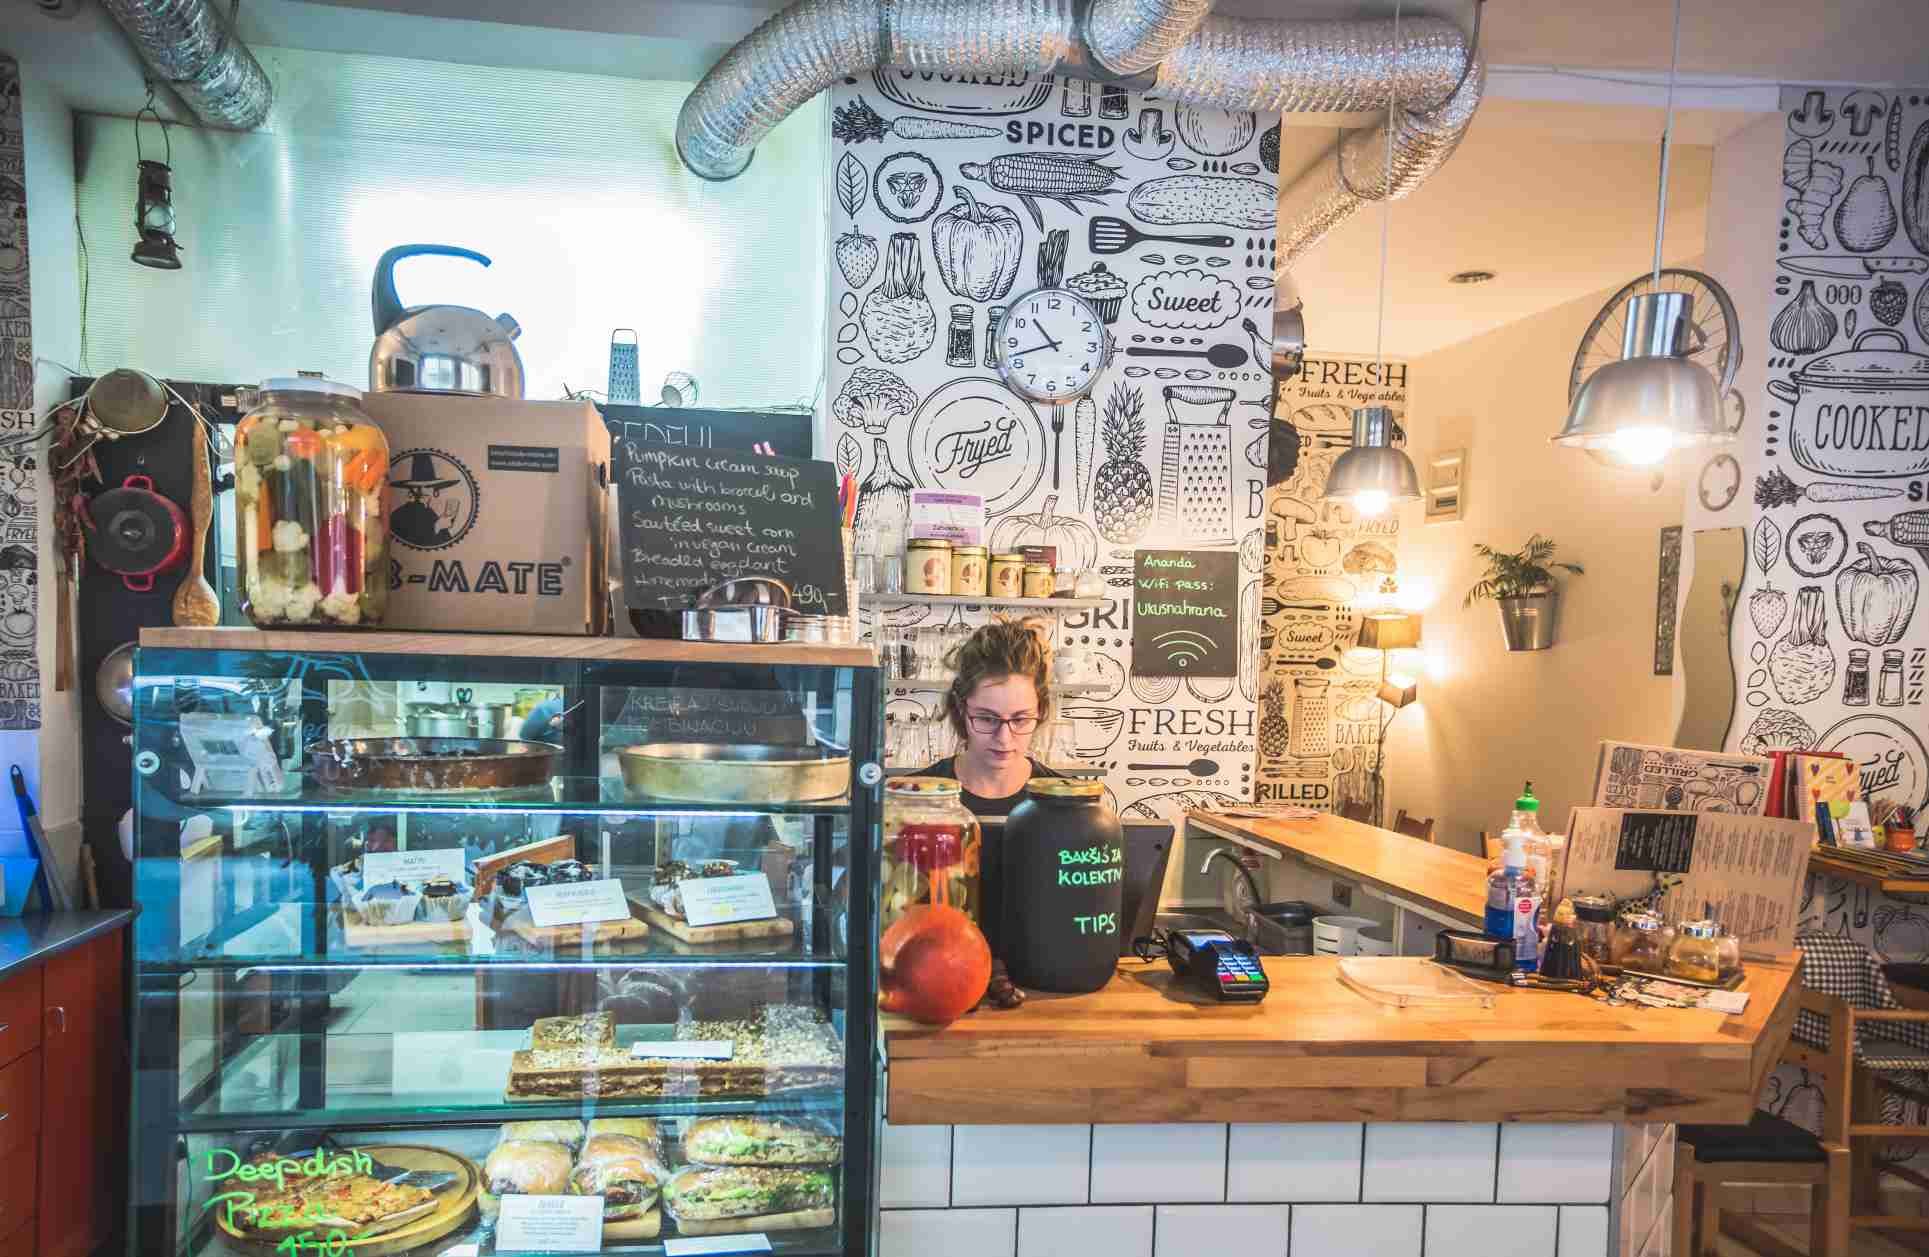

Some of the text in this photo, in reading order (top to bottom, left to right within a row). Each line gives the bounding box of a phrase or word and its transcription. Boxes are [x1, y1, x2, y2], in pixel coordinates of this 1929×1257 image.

[1006, 120, 1115, 149] SPICED
[1047, 298, 1061, 310] 12
[1147, 283, 1226, 315] Sweet
[1031, 302, 1039, 314] 11
[1015, 318, 1026, 329] 10
[1081, 321, 1092, 333] 2
[1008, 337, 1018, 348] 9
[1087, 342, 1097, 353] 3
[1013, 358, 1024, 369] 8
[1080, 362, 1090, 373] 4
[1027, 374, 1036, 385] 7
[1301, 360, 1408, 387] FRESH
[1046, 380, 1056, 392] 6
[1065, 376, 1076, 387] 5
[1298, 387, 1330, 399] Fruits
[935, 417, 1017, 479] Fryed
[625, 440, 700, 472] Pumpkin
[704, 457, 760, 475] cream
[626, 467, 672, 489] Pasta
[679, 478, 717, 496] with
[705, 521, 753, 537] sweet
[761, 527, 796, 539] corn
[746, 542, 798, 557] cream
[631, 548, 792, 578] Breaded eggplant
[1143, 554, 1197, 569] Ananda
[1286, 630, 1325, 644] Sweet
[1128, 708, 1256, 736] FRESH
[1128, 739, 1255, 756] Fruits & Vegetables
[1644, 765, 1698, 778] GRILLED
[1073, 912, 1116, 935] TIPS
[202, 1190, 333, 1233] Pizza
